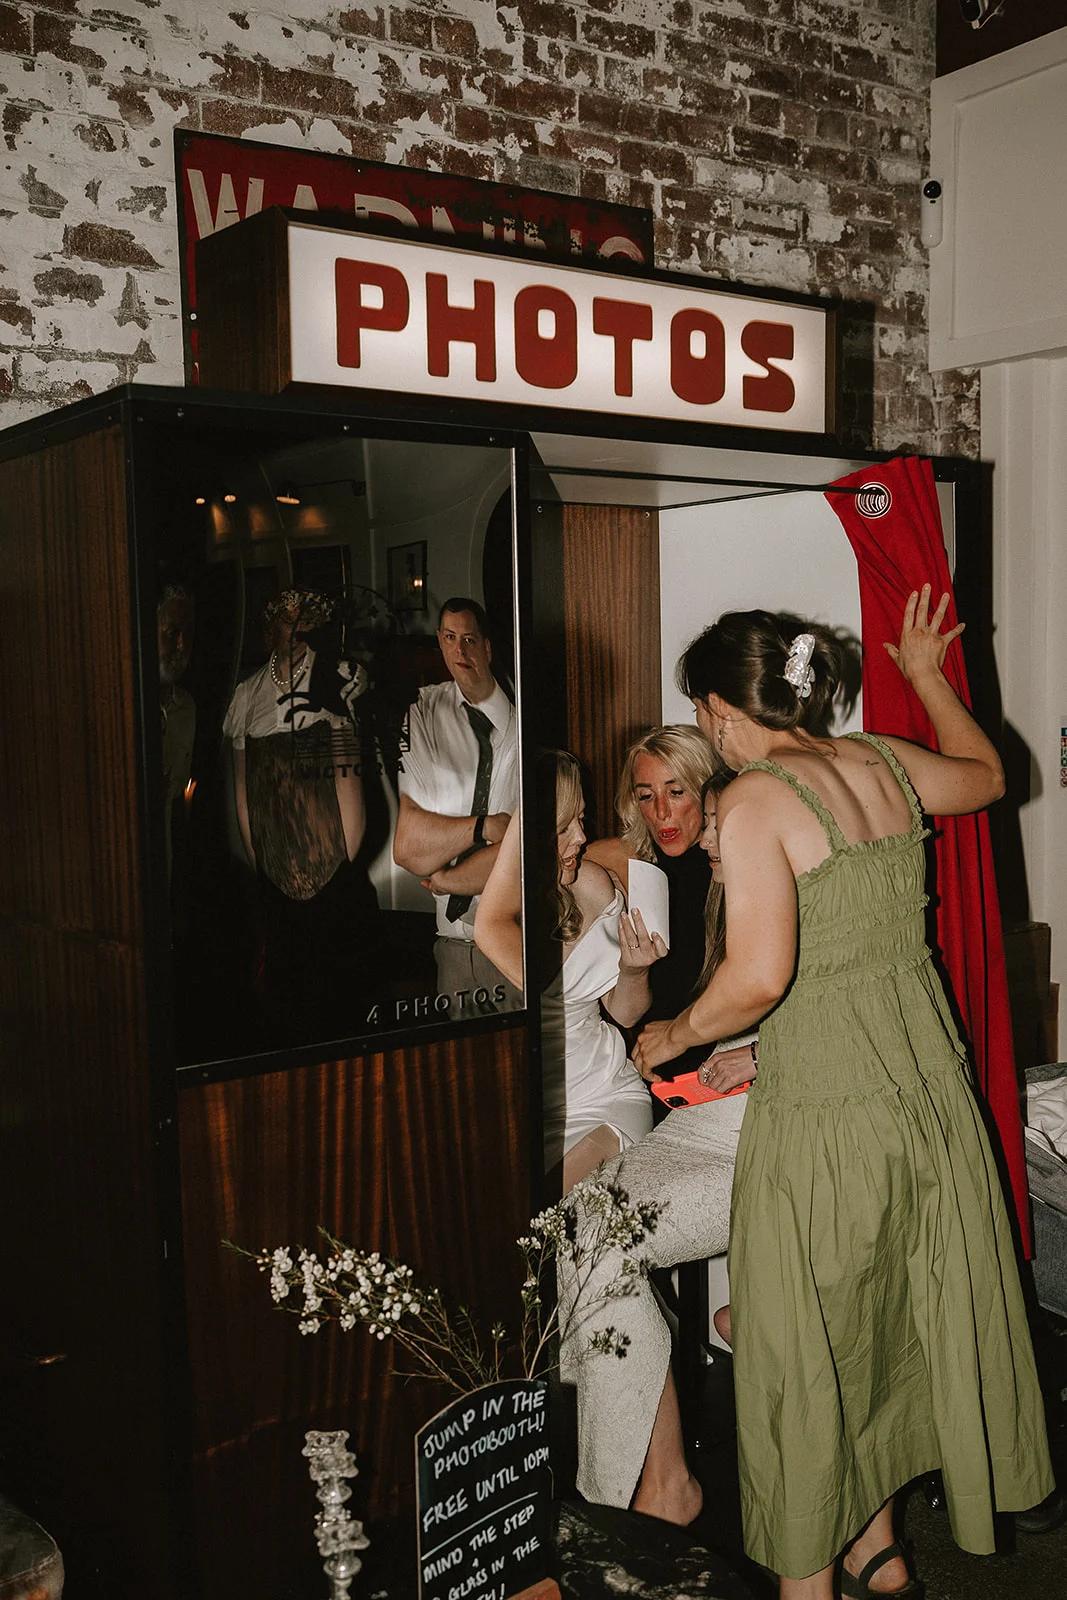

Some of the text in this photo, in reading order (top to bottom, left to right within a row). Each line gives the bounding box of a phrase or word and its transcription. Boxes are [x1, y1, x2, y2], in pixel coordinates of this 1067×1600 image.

[335, 257, 796, 412] PHOTOS
[366, 984, 506, 1024] 4 PHOTOS
[423, 1389, 546, 1459] JUMP IN THE
[434, 1410, 545, 1479] PHOTOBOOTH!
[422, 1488, 469, 1533] FREE
[475, 1465, 520, 1502] UNTIL
[423, 1504, 535, 1583] MIND THE STEP
[448, 1567, 488, 1600] GLASS
[491, 1555, 505, 1575] IN
[512, 1536, 540, 1561] THE
